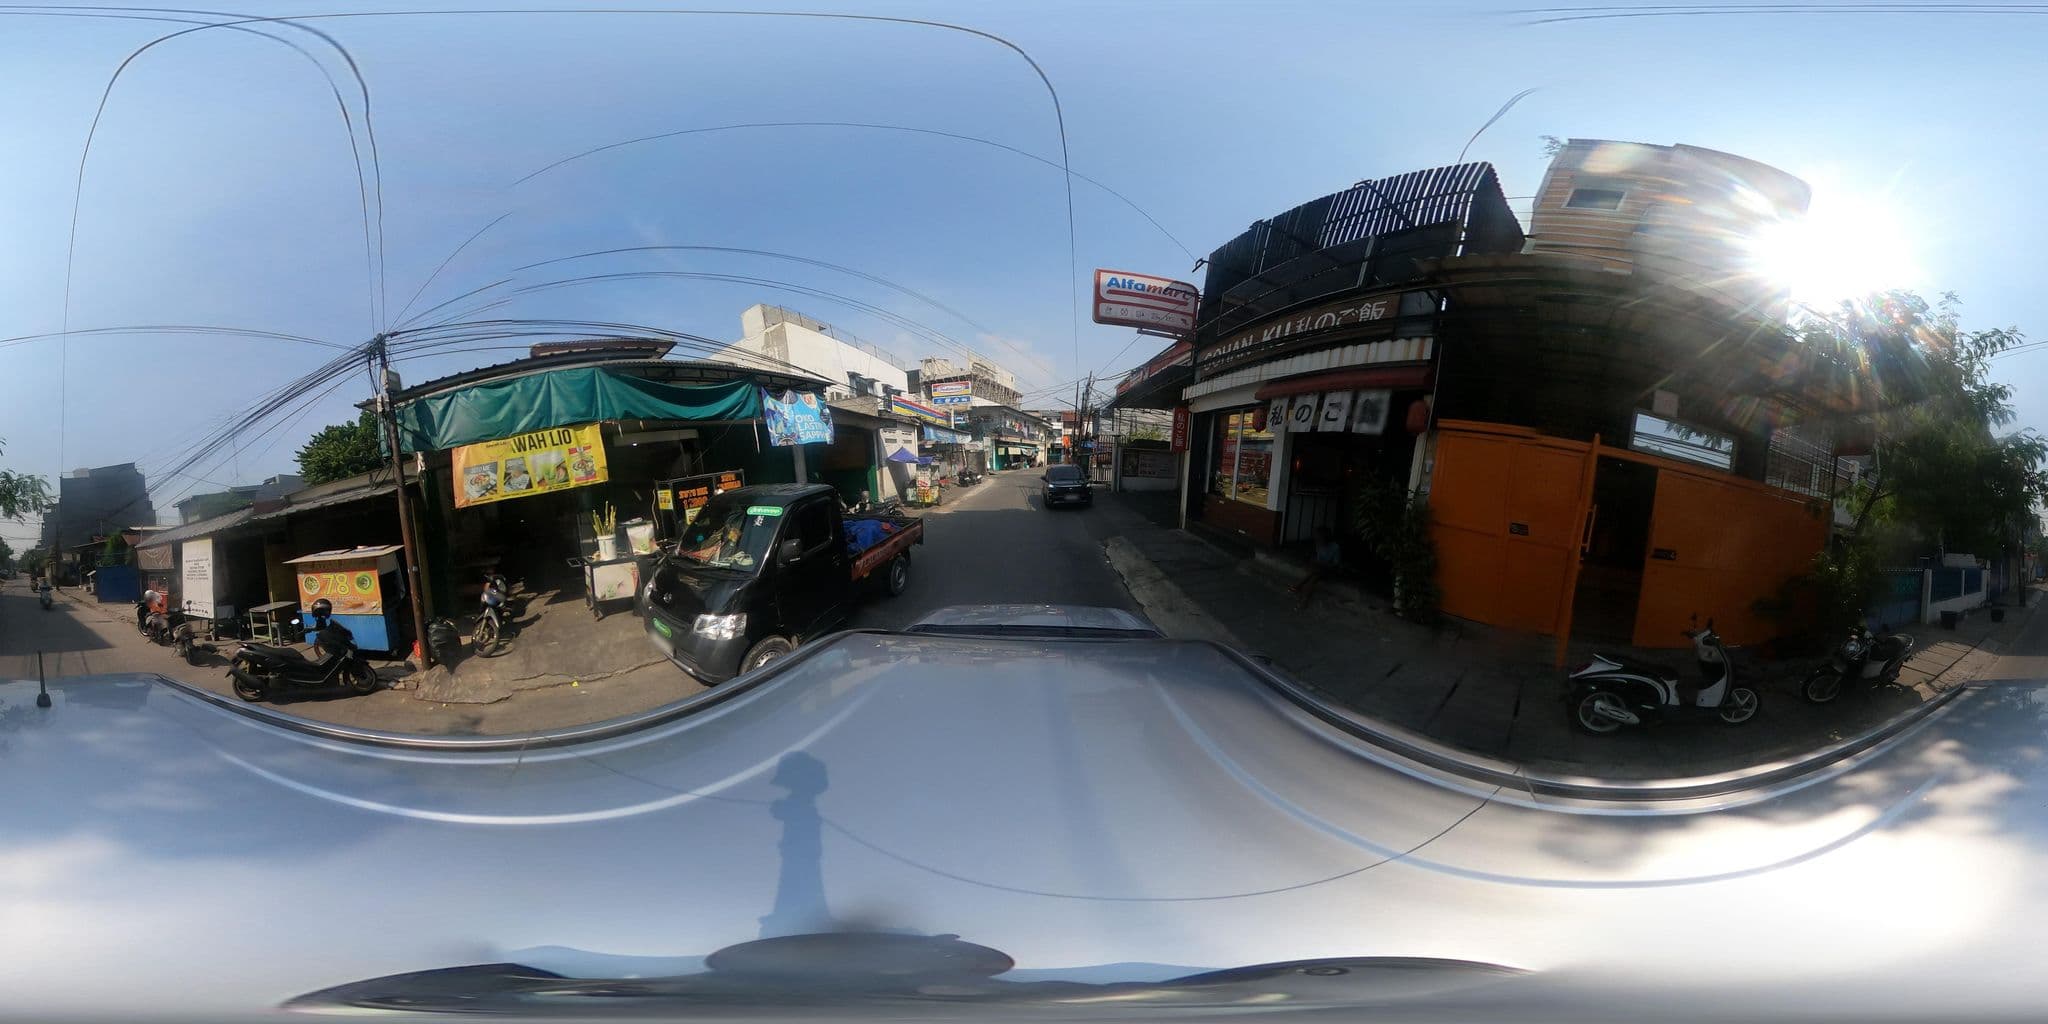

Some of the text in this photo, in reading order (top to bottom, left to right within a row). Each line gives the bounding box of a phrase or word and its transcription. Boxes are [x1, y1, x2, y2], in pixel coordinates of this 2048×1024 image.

[1106, 277, 1190, 300] Alfamart
[1269, 399, 1383, 427] 私のご
[513, 428, 573, 455] WAH LIO
[321, 572, 351, 597] 78
